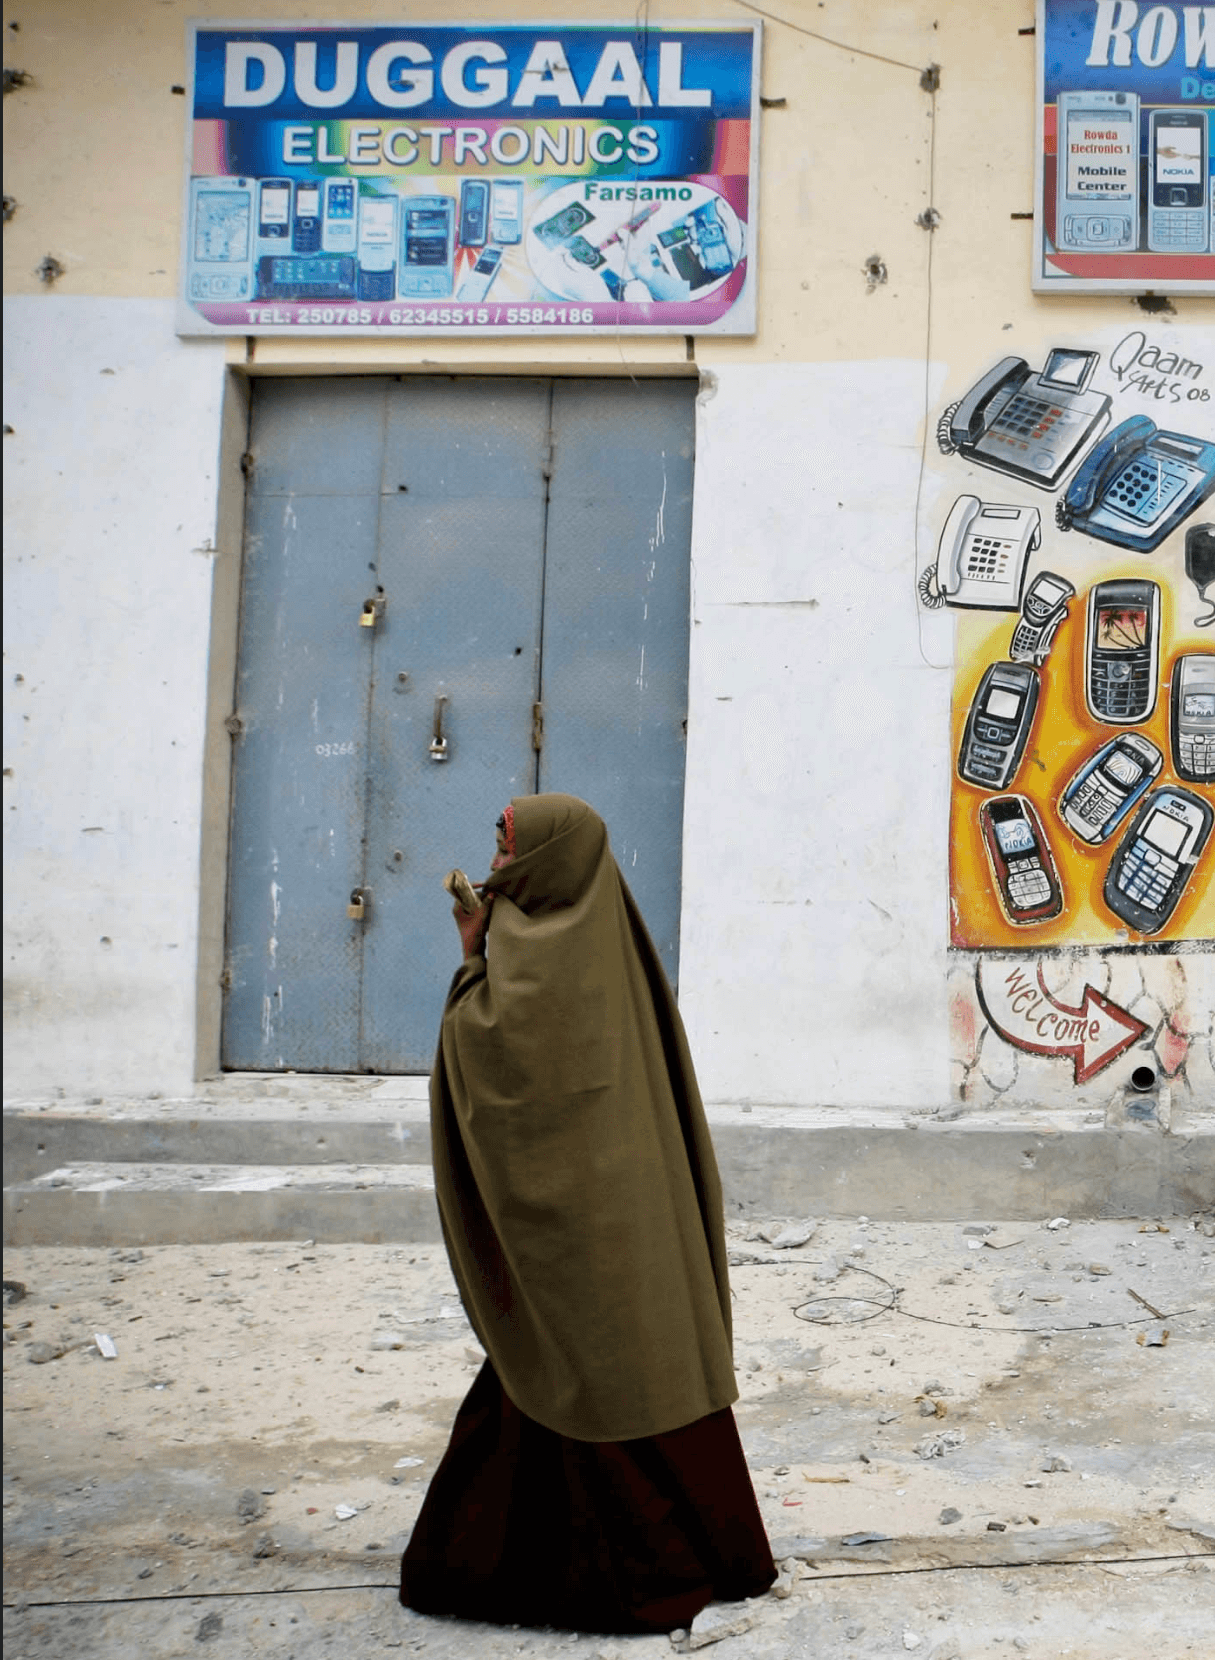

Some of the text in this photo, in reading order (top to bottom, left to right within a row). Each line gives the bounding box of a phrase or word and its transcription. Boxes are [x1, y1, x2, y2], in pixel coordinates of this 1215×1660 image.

[224, 41, 712, 108] DUGGAAL
[1084, 130, 1118, 141] Rowda
[282, 125, 660, 166] ELECTRONICS
[1070, 144, 1123, 154] Electronics
[1077, 166, 1127, 176] Mobile
[585, 183, 693, 201] Farsamo
[1077, 182, 1128, 191] Center
[247, 308, 291, 324] TEL:
[297, 308, 372, 324] 250785
[390, 308, 489, 324] 62345515
[507, 308, 594, 324] 5584186
[1109, 331, 1203, 381] Qaam
